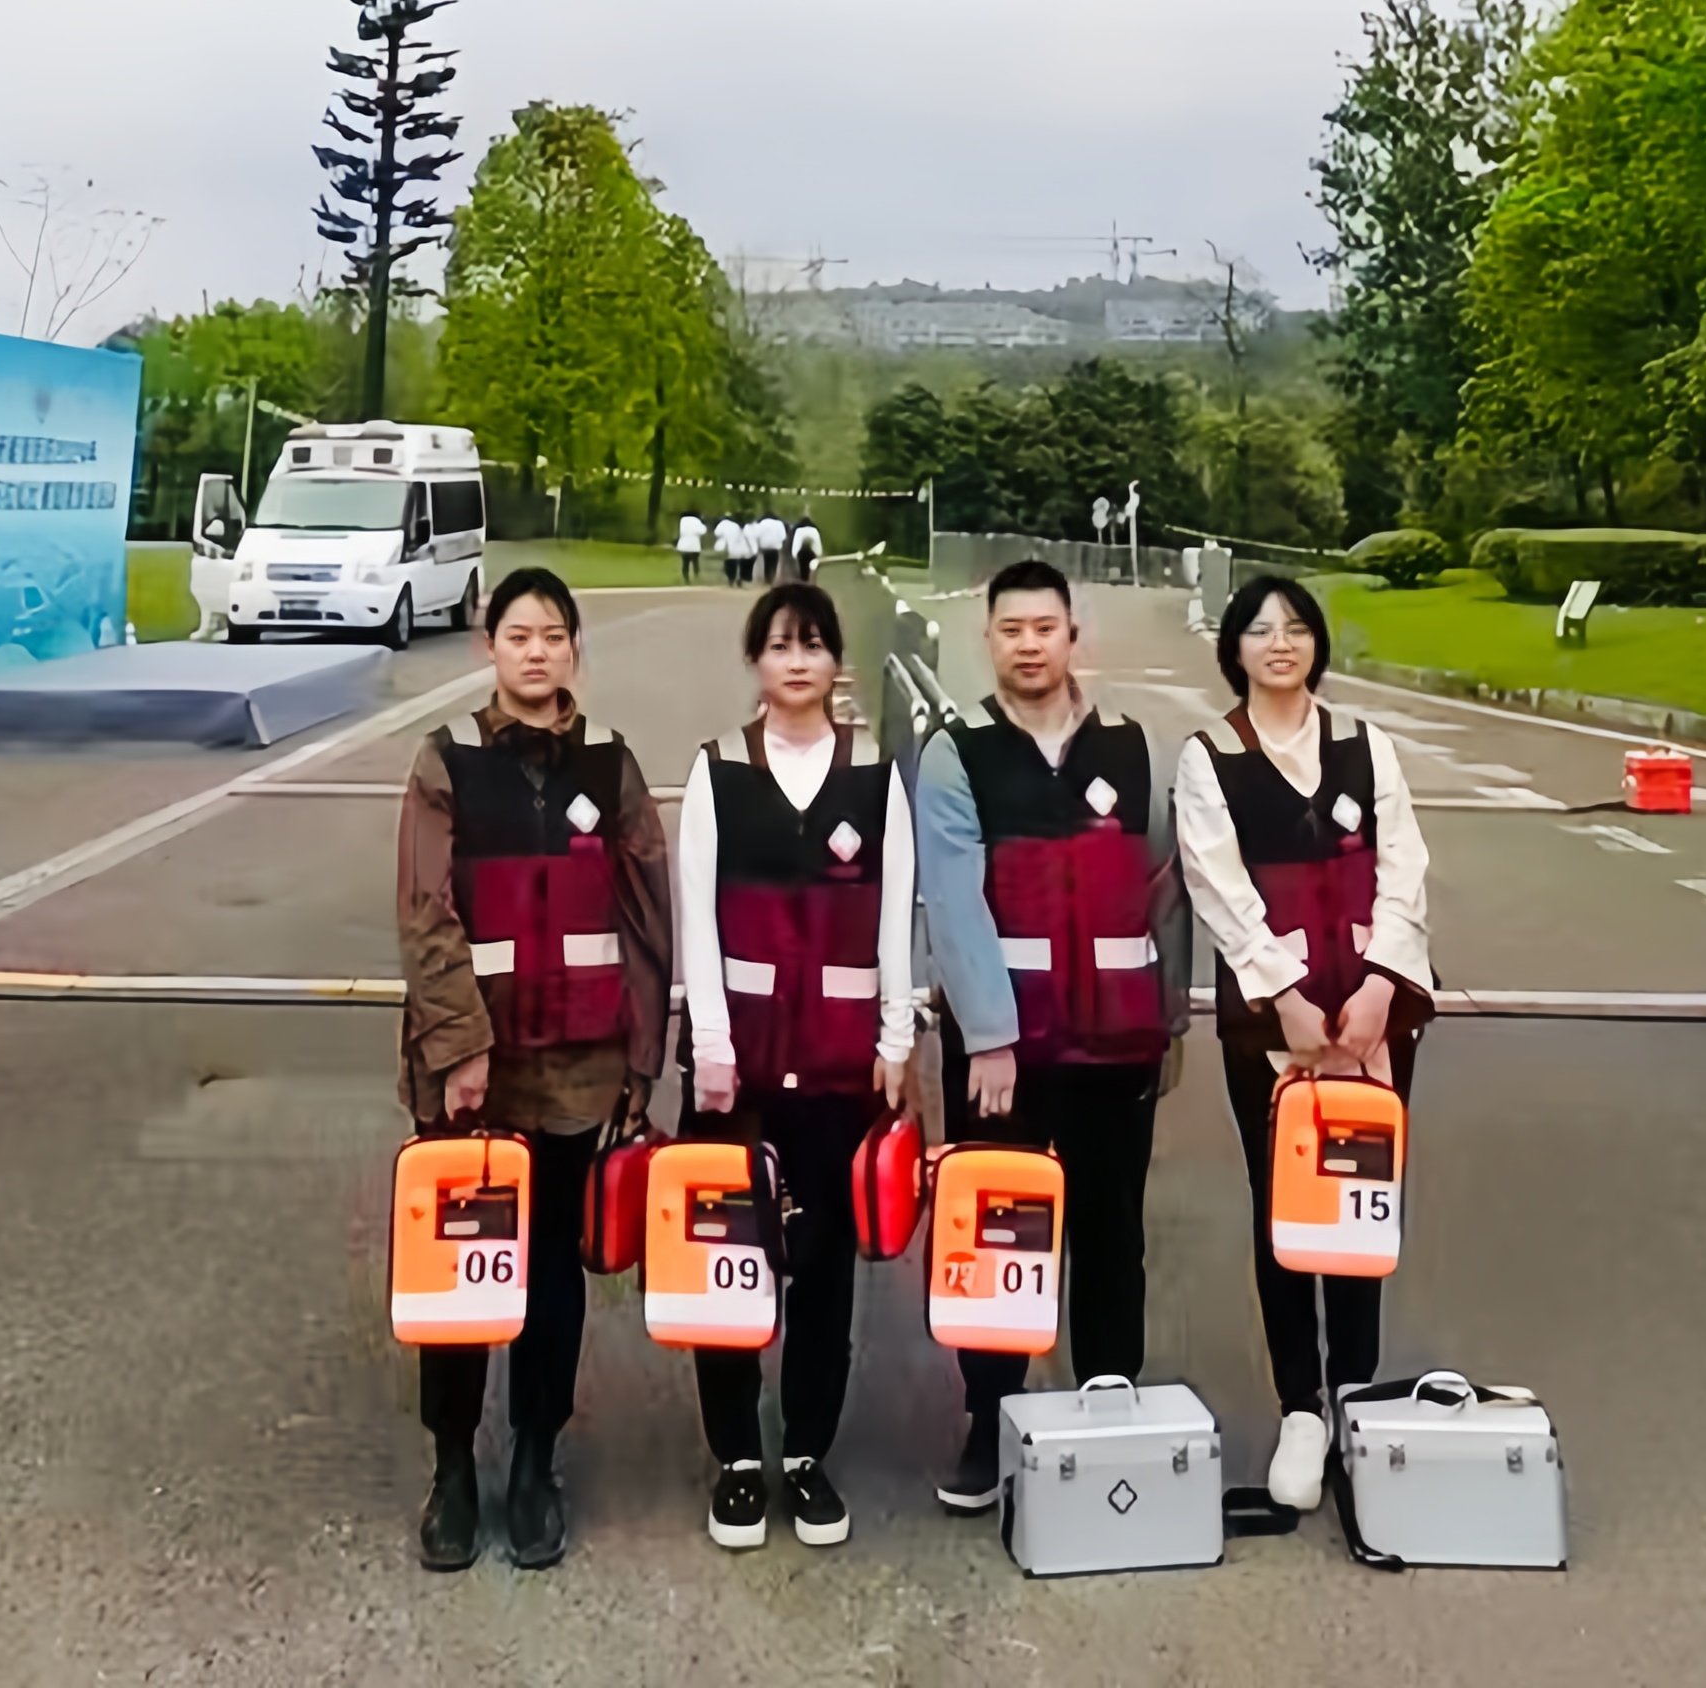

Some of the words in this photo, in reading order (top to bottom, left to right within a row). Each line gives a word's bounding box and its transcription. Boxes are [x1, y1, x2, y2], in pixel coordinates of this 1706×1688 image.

[1349, 1189, 1391, 1222] 15
[464, 1249, 514, 1284] 06
[713, 1256, 760, 1291] 09
[1002, 1260, 1044, 1296] 01
